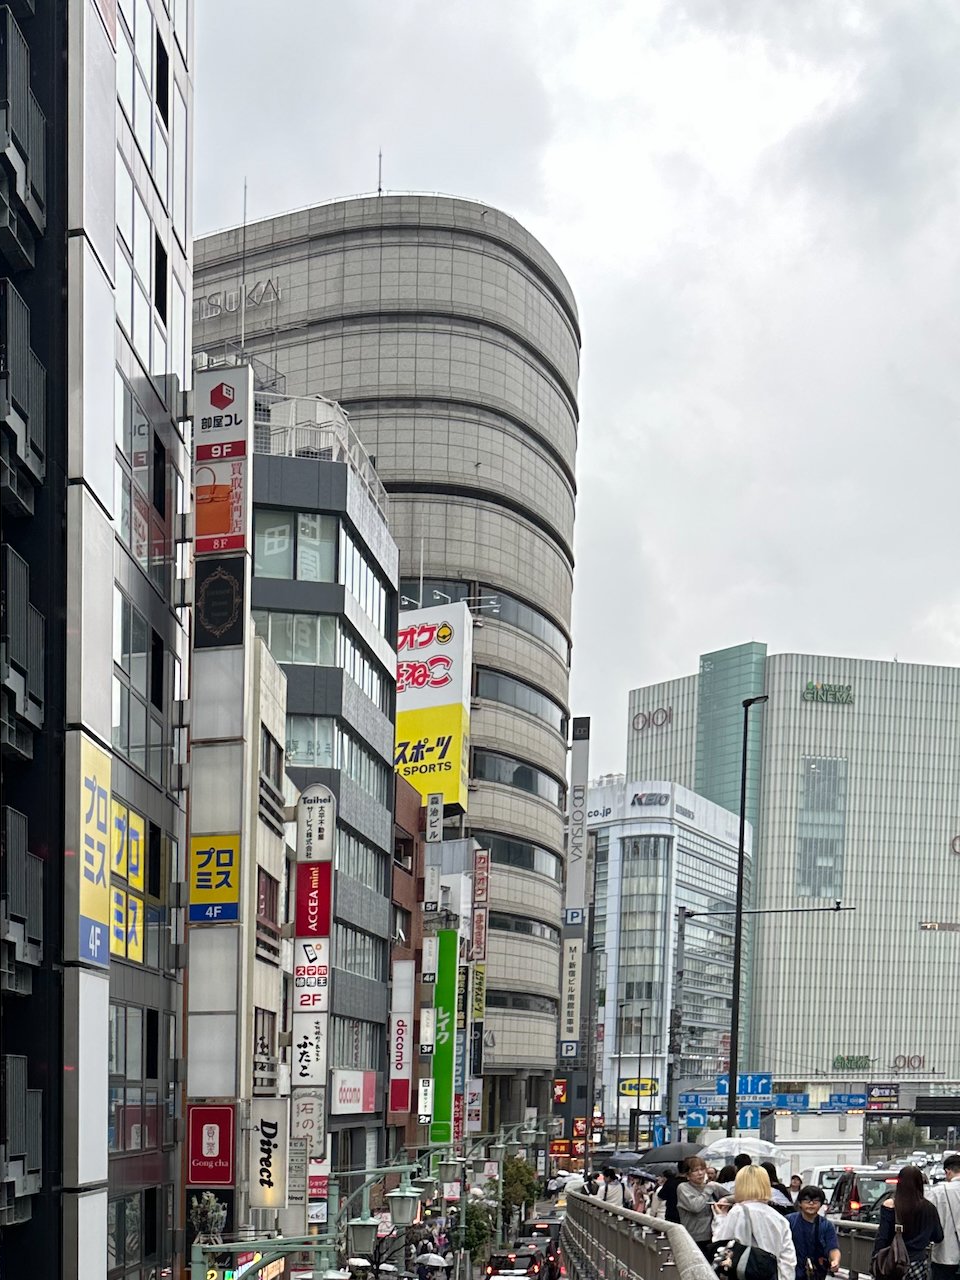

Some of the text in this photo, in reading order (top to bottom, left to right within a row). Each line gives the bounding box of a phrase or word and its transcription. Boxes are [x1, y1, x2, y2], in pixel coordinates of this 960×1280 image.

[201, 413, 243, 429] 部屋コレ
[211, 444, 232, 457] 9F
[231, 462, 242, 534] 買取専門店
[213, 539, 228, 549] 8F
[803, 690, 855, 704] CINEMA
[394, 736, 452, 765] スポーツ
[403, 761, 451, 776] SPORTS
[84, 775, 108, 834] プロ
[631, 792, 670, 806] KEIO
[571, 809, 585, 863] OTSUKA
[114, 814, 140, 878] プロ
[83, 834, 107, 889] ミス
[196, 847, 234, 868] プロ
[196, 870, 233, 889] ミス
[205, 906, 222, 918] 4F
[308, 890, 319, 932] ACCEA
[426, 903, 437, 911] 5F
[113, 892, 138, 946] ミス
[570, 912, 580, 922] P
[88, 925, 101, 957] 4F
[296, 966, 327, 976] スマホ
[423, 974, 435, 982] 4F
[300, 994, 322, 1006] 2F
[437, 1006, 450, 1044] レイク
[395, 1020, 407, 1070] docomo
[422, 1045, 432, 1053] 3F
[566, 1045, 574, 1055] P
[621, 1083, 656, 1091] IKEA
[419, 1115, 431, 1123] 2F
[259, 1118, 278, 1188] Direct
[192, 1159, 228, 1168] Gong cha
